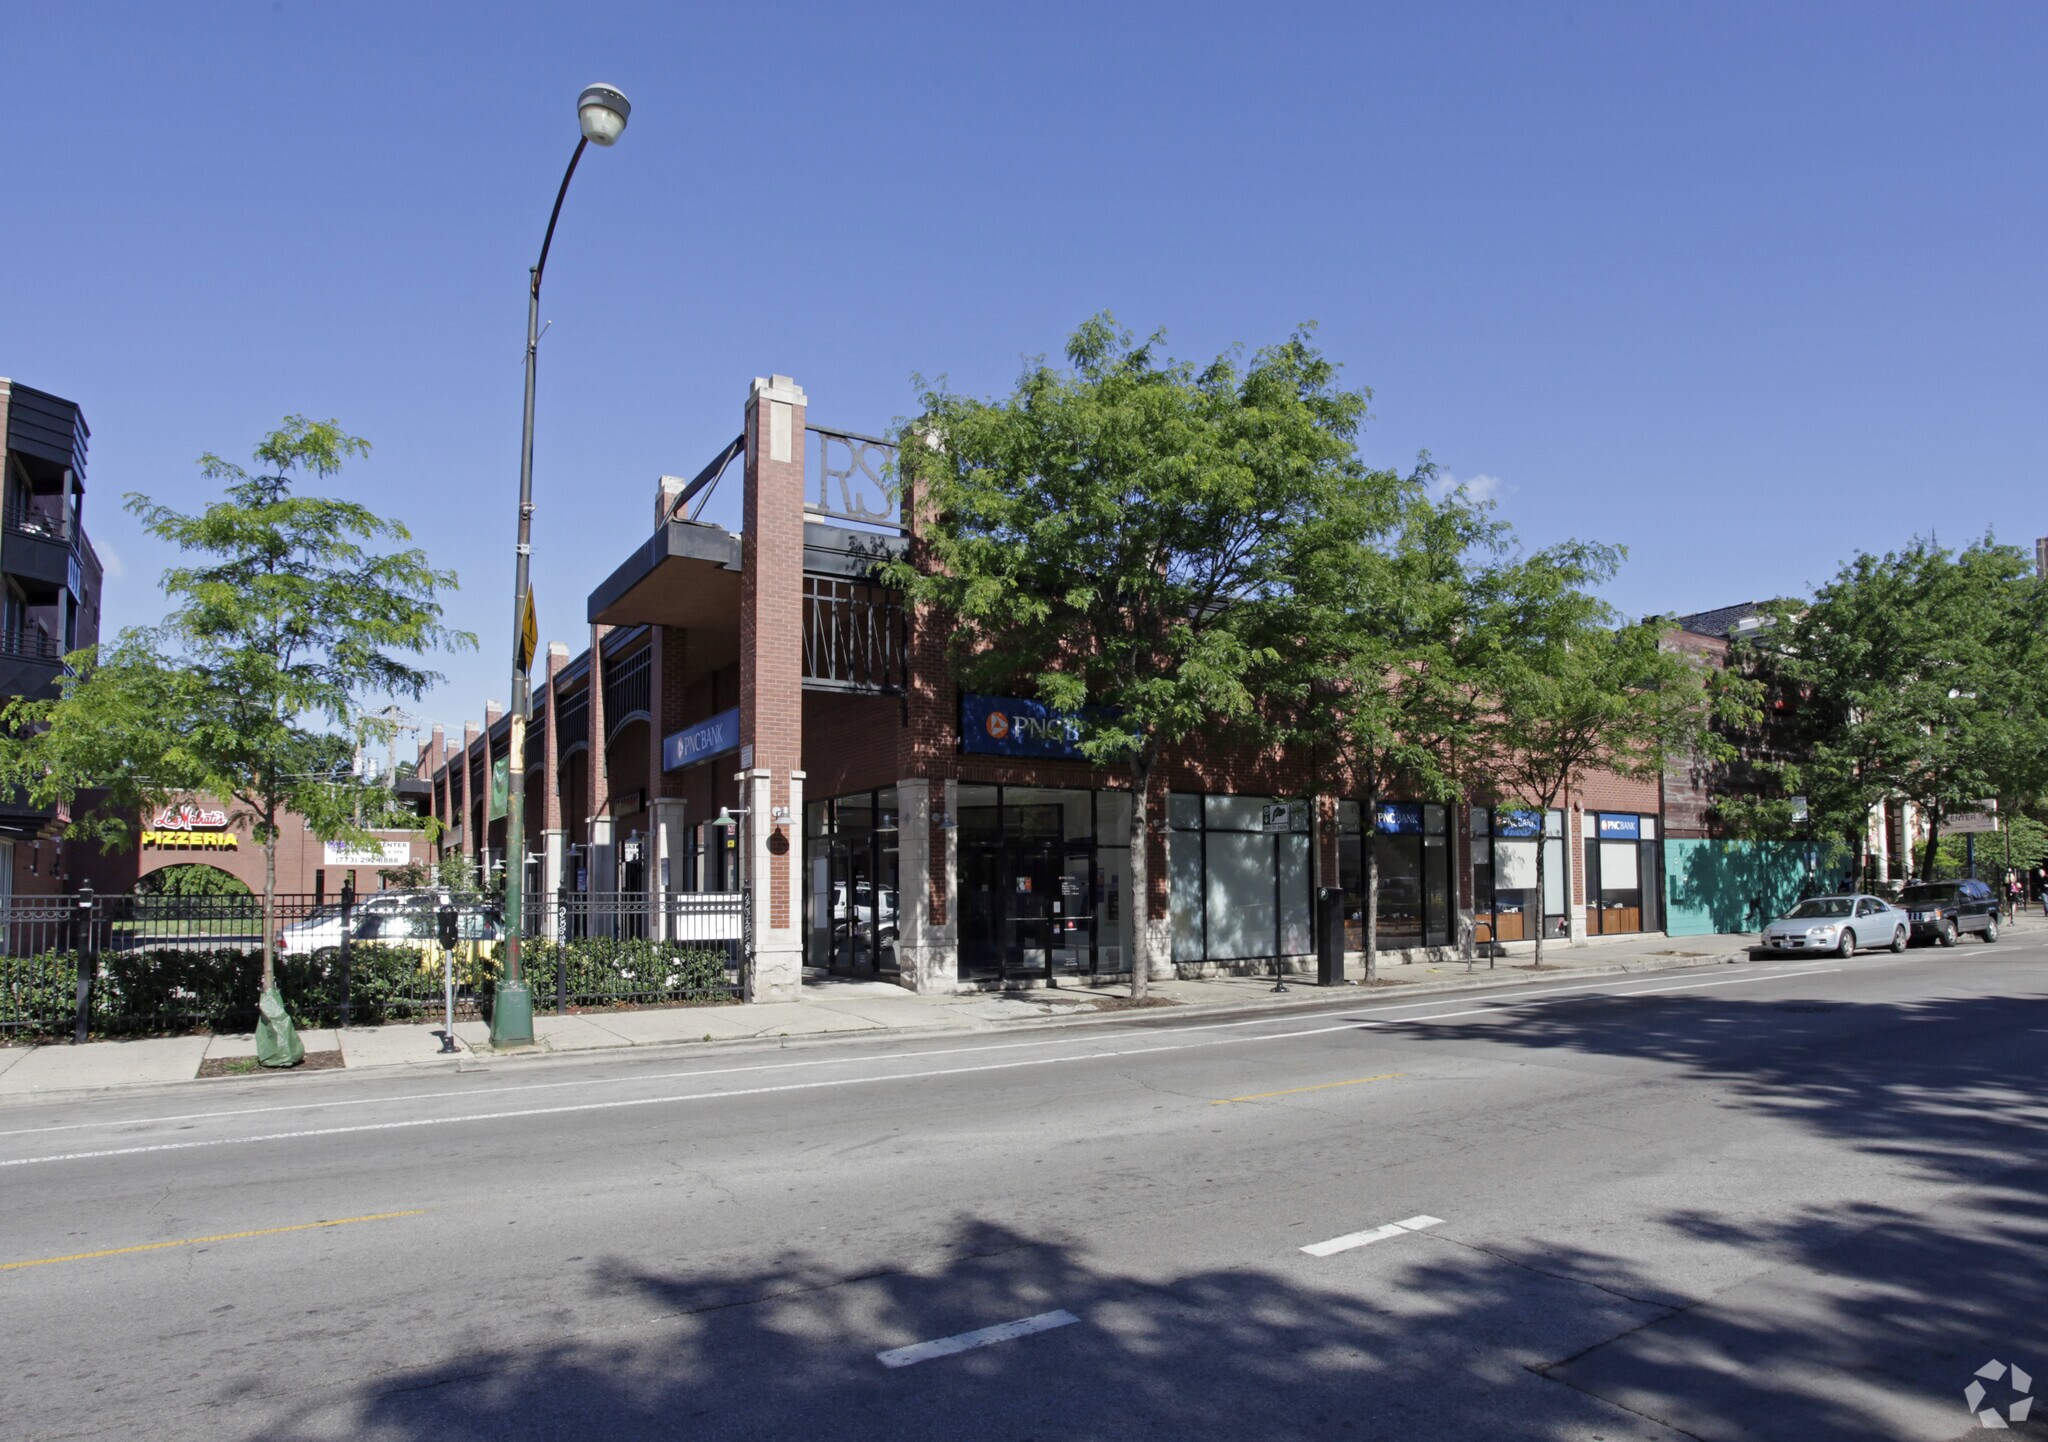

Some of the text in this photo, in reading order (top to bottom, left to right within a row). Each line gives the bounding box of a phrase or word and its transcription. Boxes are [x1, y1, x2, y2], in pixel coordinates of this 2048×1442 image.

[684, 723, 723, 756] PNC BANK
[1377, 812, 1396, 824] PNC
[1607, 820, 1636, 830] PNC BANK
[141, 831, 238, 845] PIZZERIA
